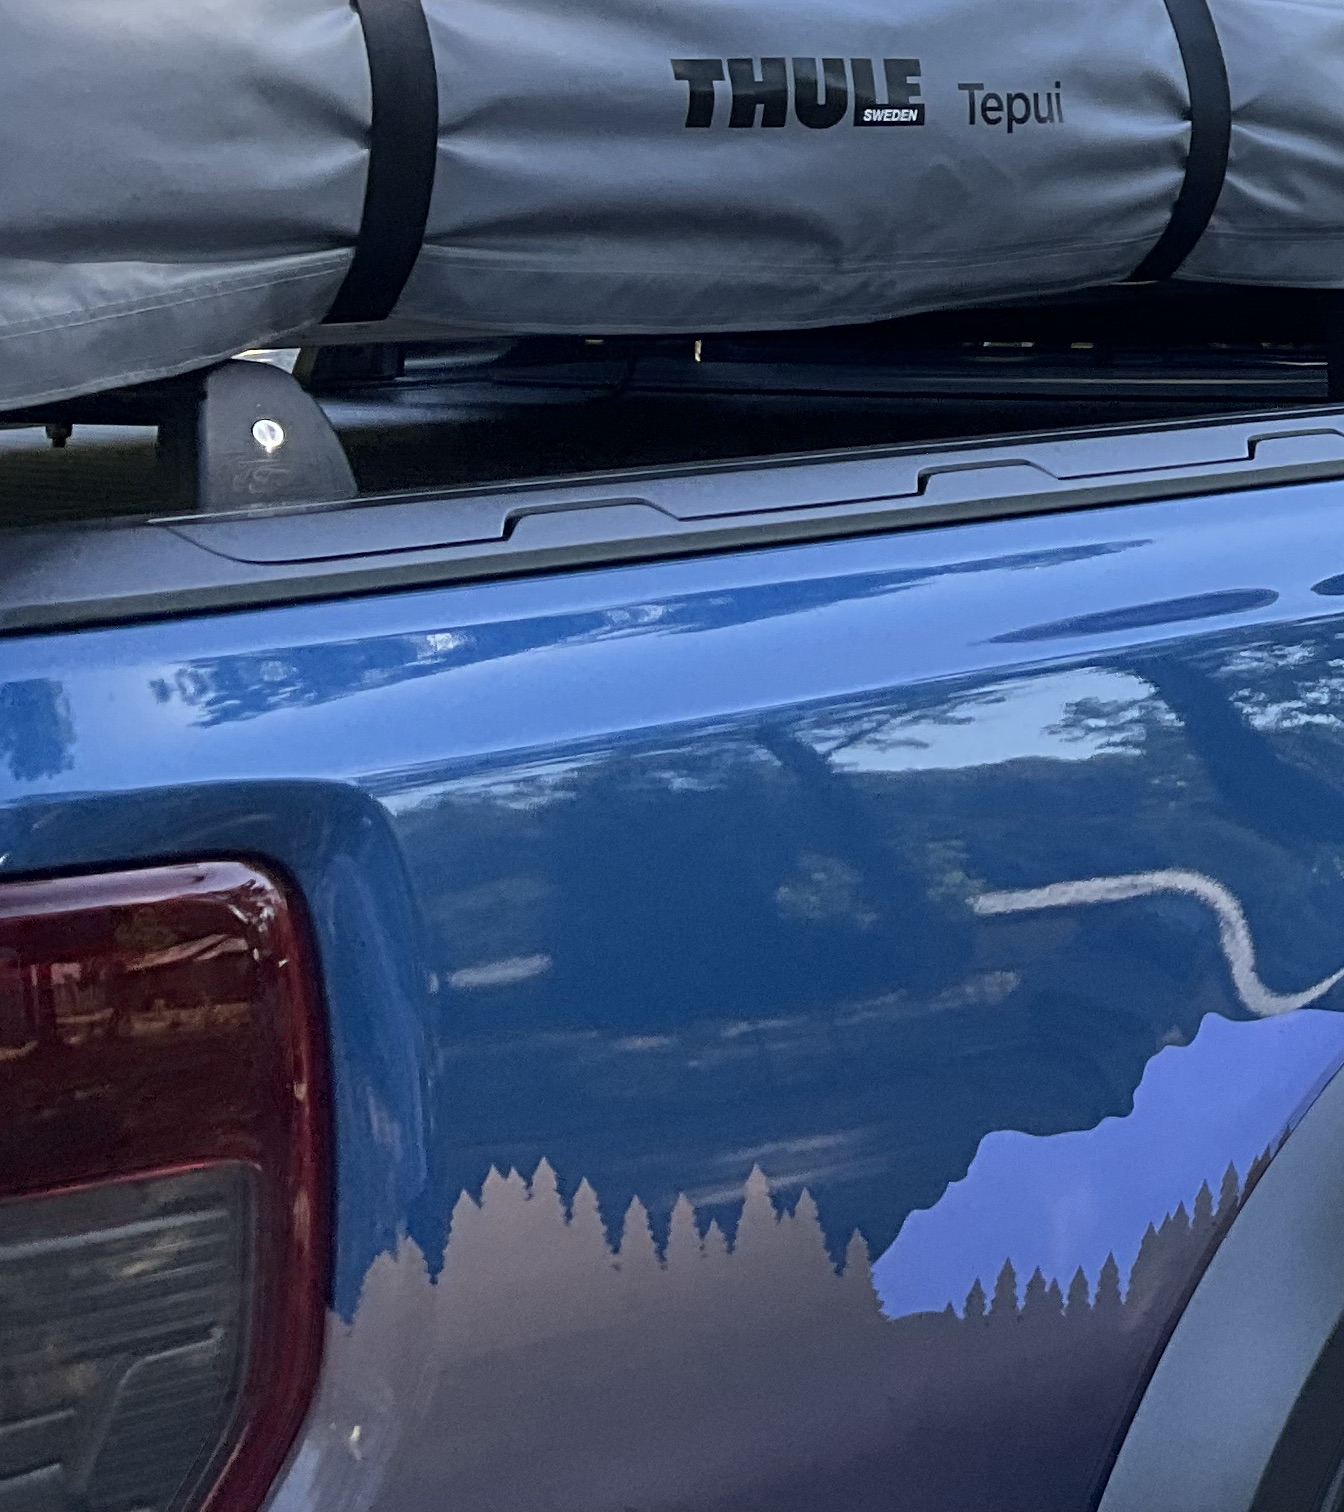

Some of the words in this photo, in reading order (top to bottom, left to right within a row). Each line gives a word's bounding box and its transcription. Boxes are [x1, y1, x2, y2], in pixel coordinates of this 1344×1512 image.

[670, 57, 924, 129] THULE
[958, 80, 1065, 134] Tepui
[862, 108, 919, 123] SWEDEN
